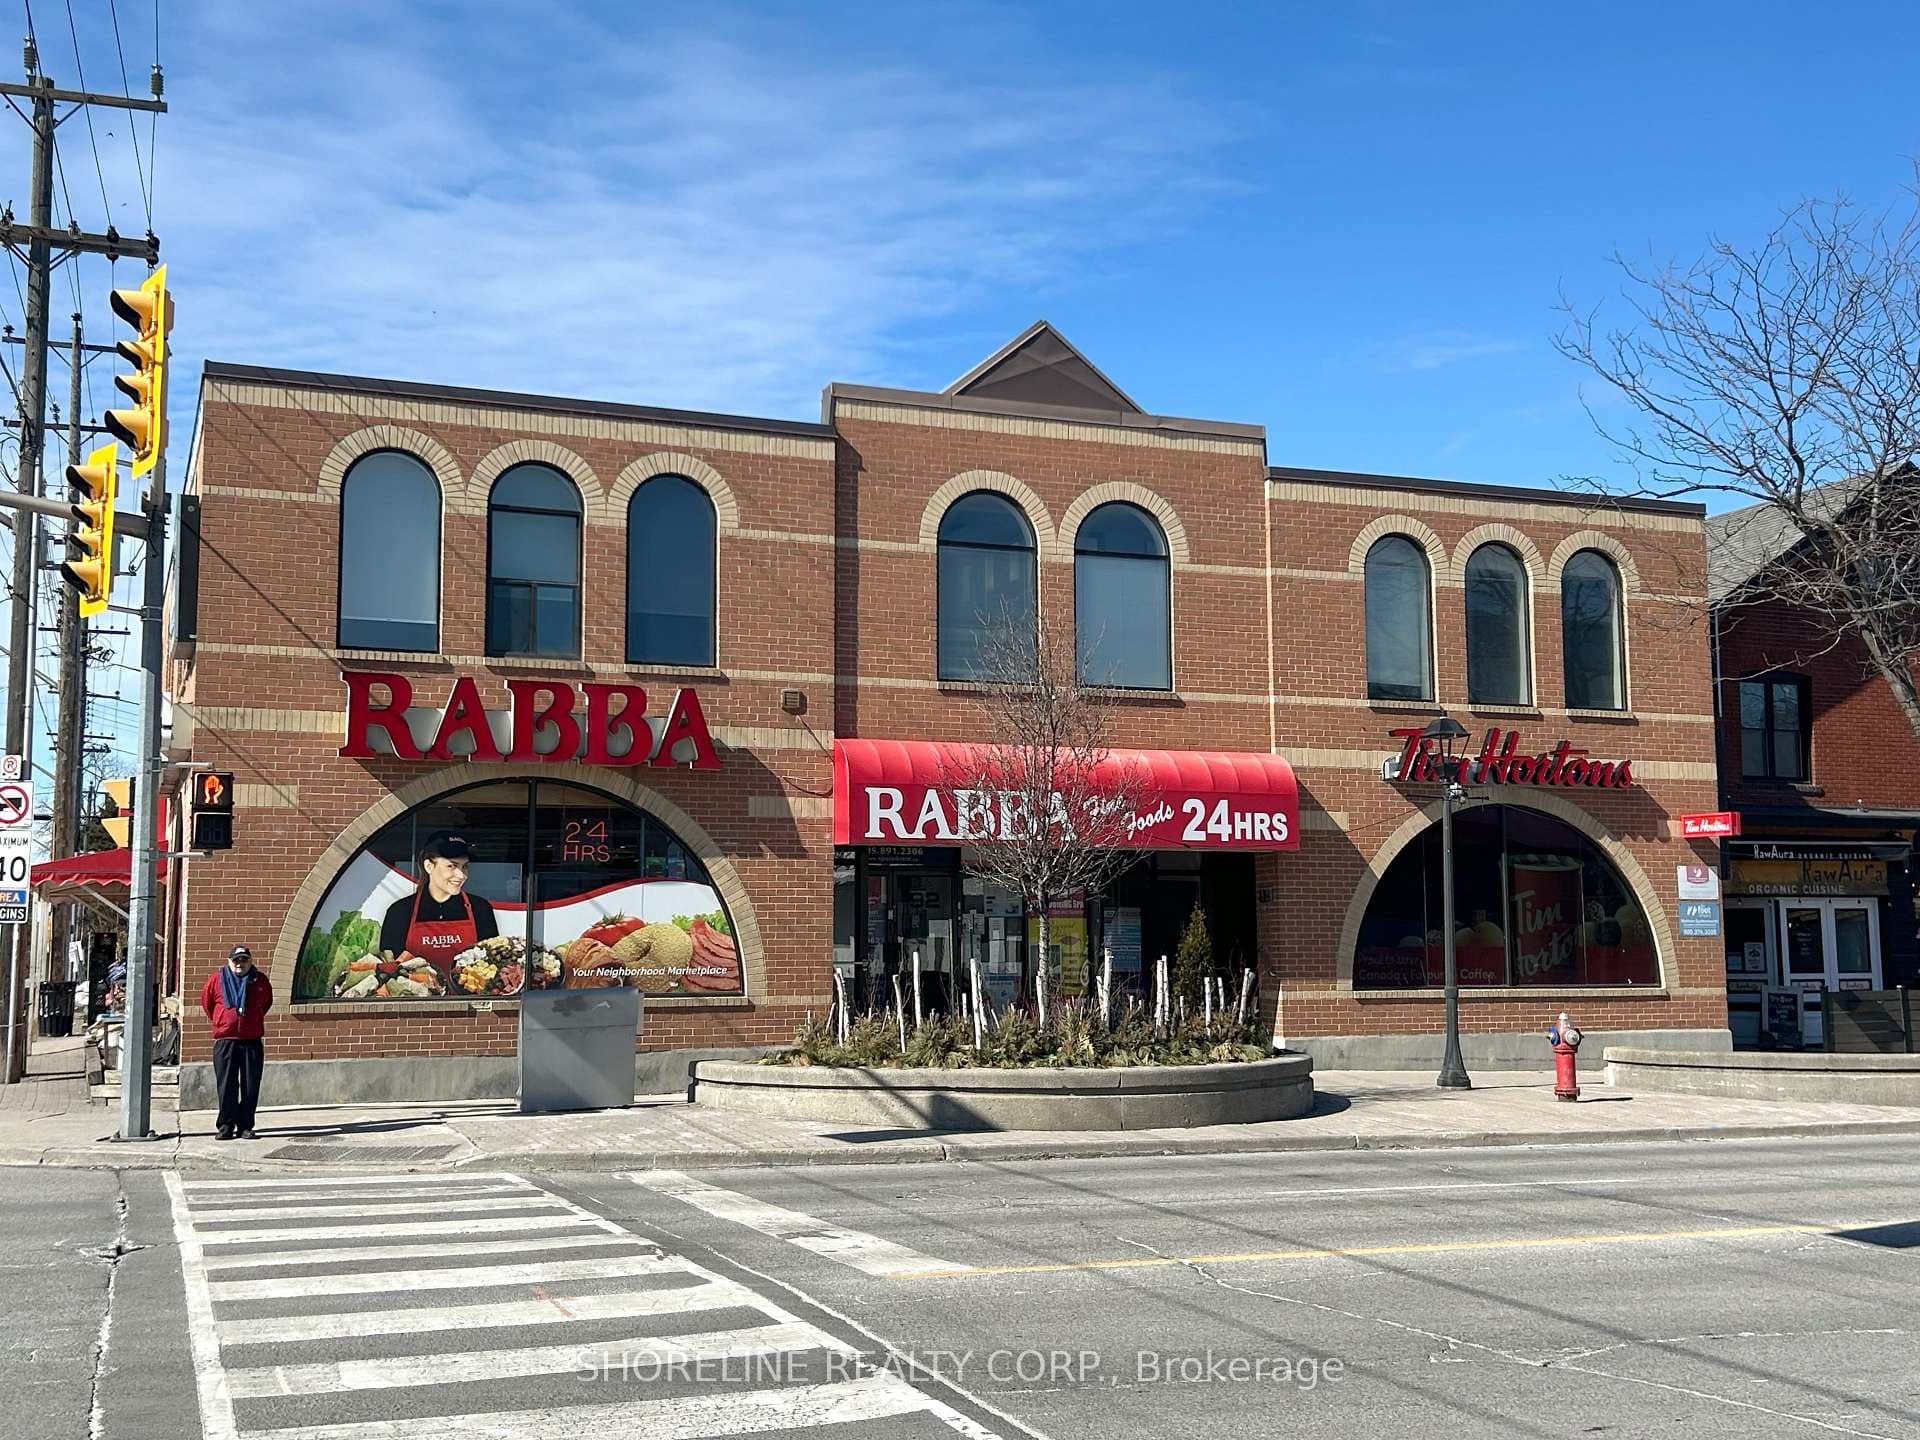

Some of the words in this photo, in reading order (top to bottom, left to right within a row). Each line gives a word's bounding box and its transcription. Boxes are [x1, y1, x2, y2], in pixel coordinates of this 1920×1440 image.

[337, 671, 721, 769] RABBA
[1474, 727, 1633, 787] Hortons
[565, 821, 609, 843] 24
[1685, 820, 1700, 832] Tim
[1700, 818, 1730, 831] Hortons
[564, 844, 610, 862] HRS
[1749, 885, 1797, 895] ORGANIC
[1802, 885, 1847, 895] CUISINE
[1515, 890, 1563, 935] Tim
[422, 935, 462, 945] RABBA
[572, 968, 595, 977] Your
[597, 968, 665, 978] Neighborhood
[667, 966, 728, 977] Marketplace
